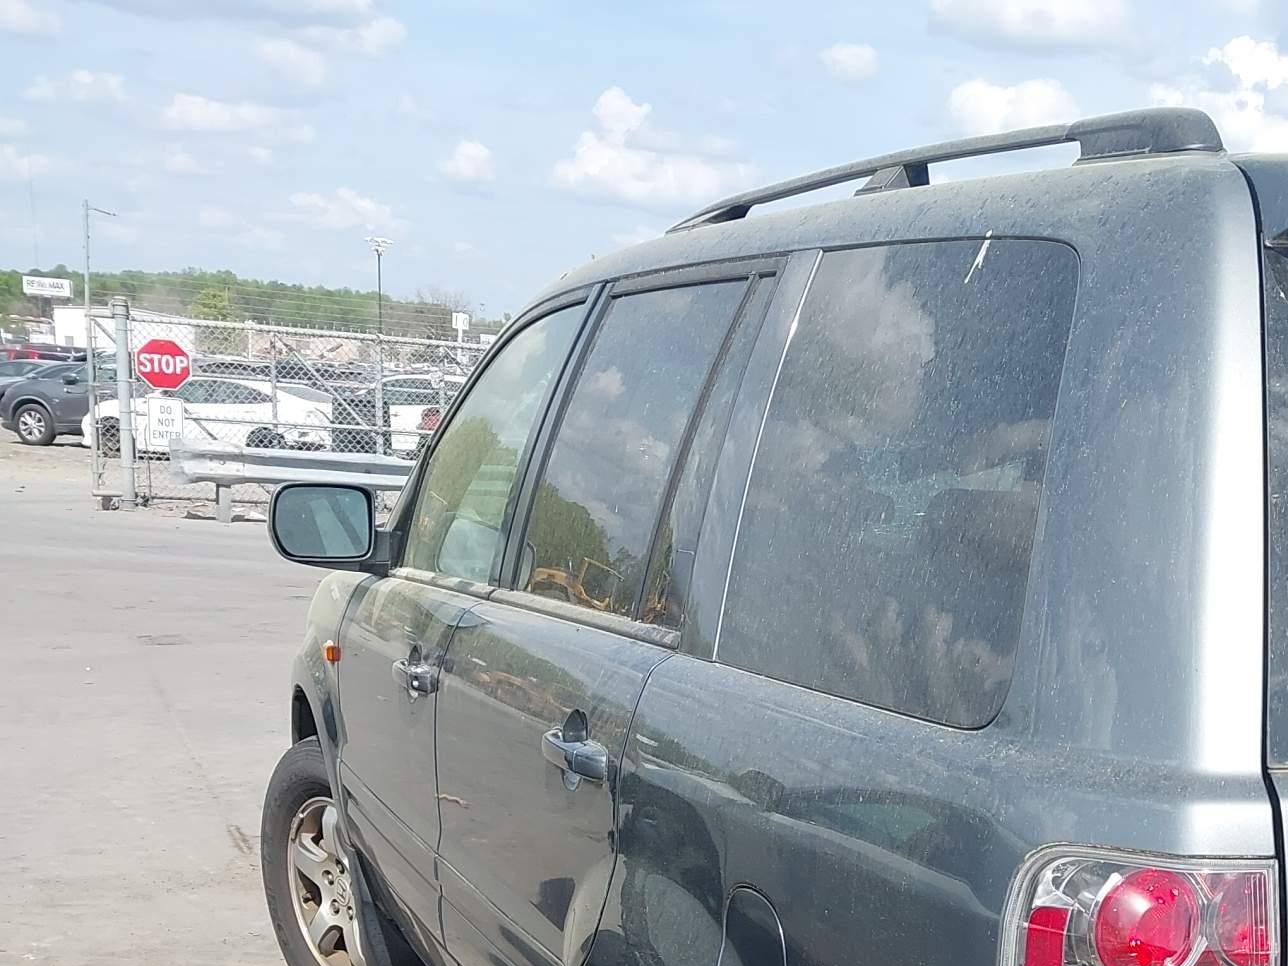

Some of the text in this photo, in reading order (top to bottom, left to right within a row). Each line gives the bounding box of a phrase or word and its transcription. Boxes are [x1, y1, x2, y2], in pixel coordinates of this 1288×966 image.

[139, 352, 188, 375] STOP
[159, 405, 172, 415] DO
[157, 418, 175, 428] NOT
[152, 429, 182, 440] ENTER
